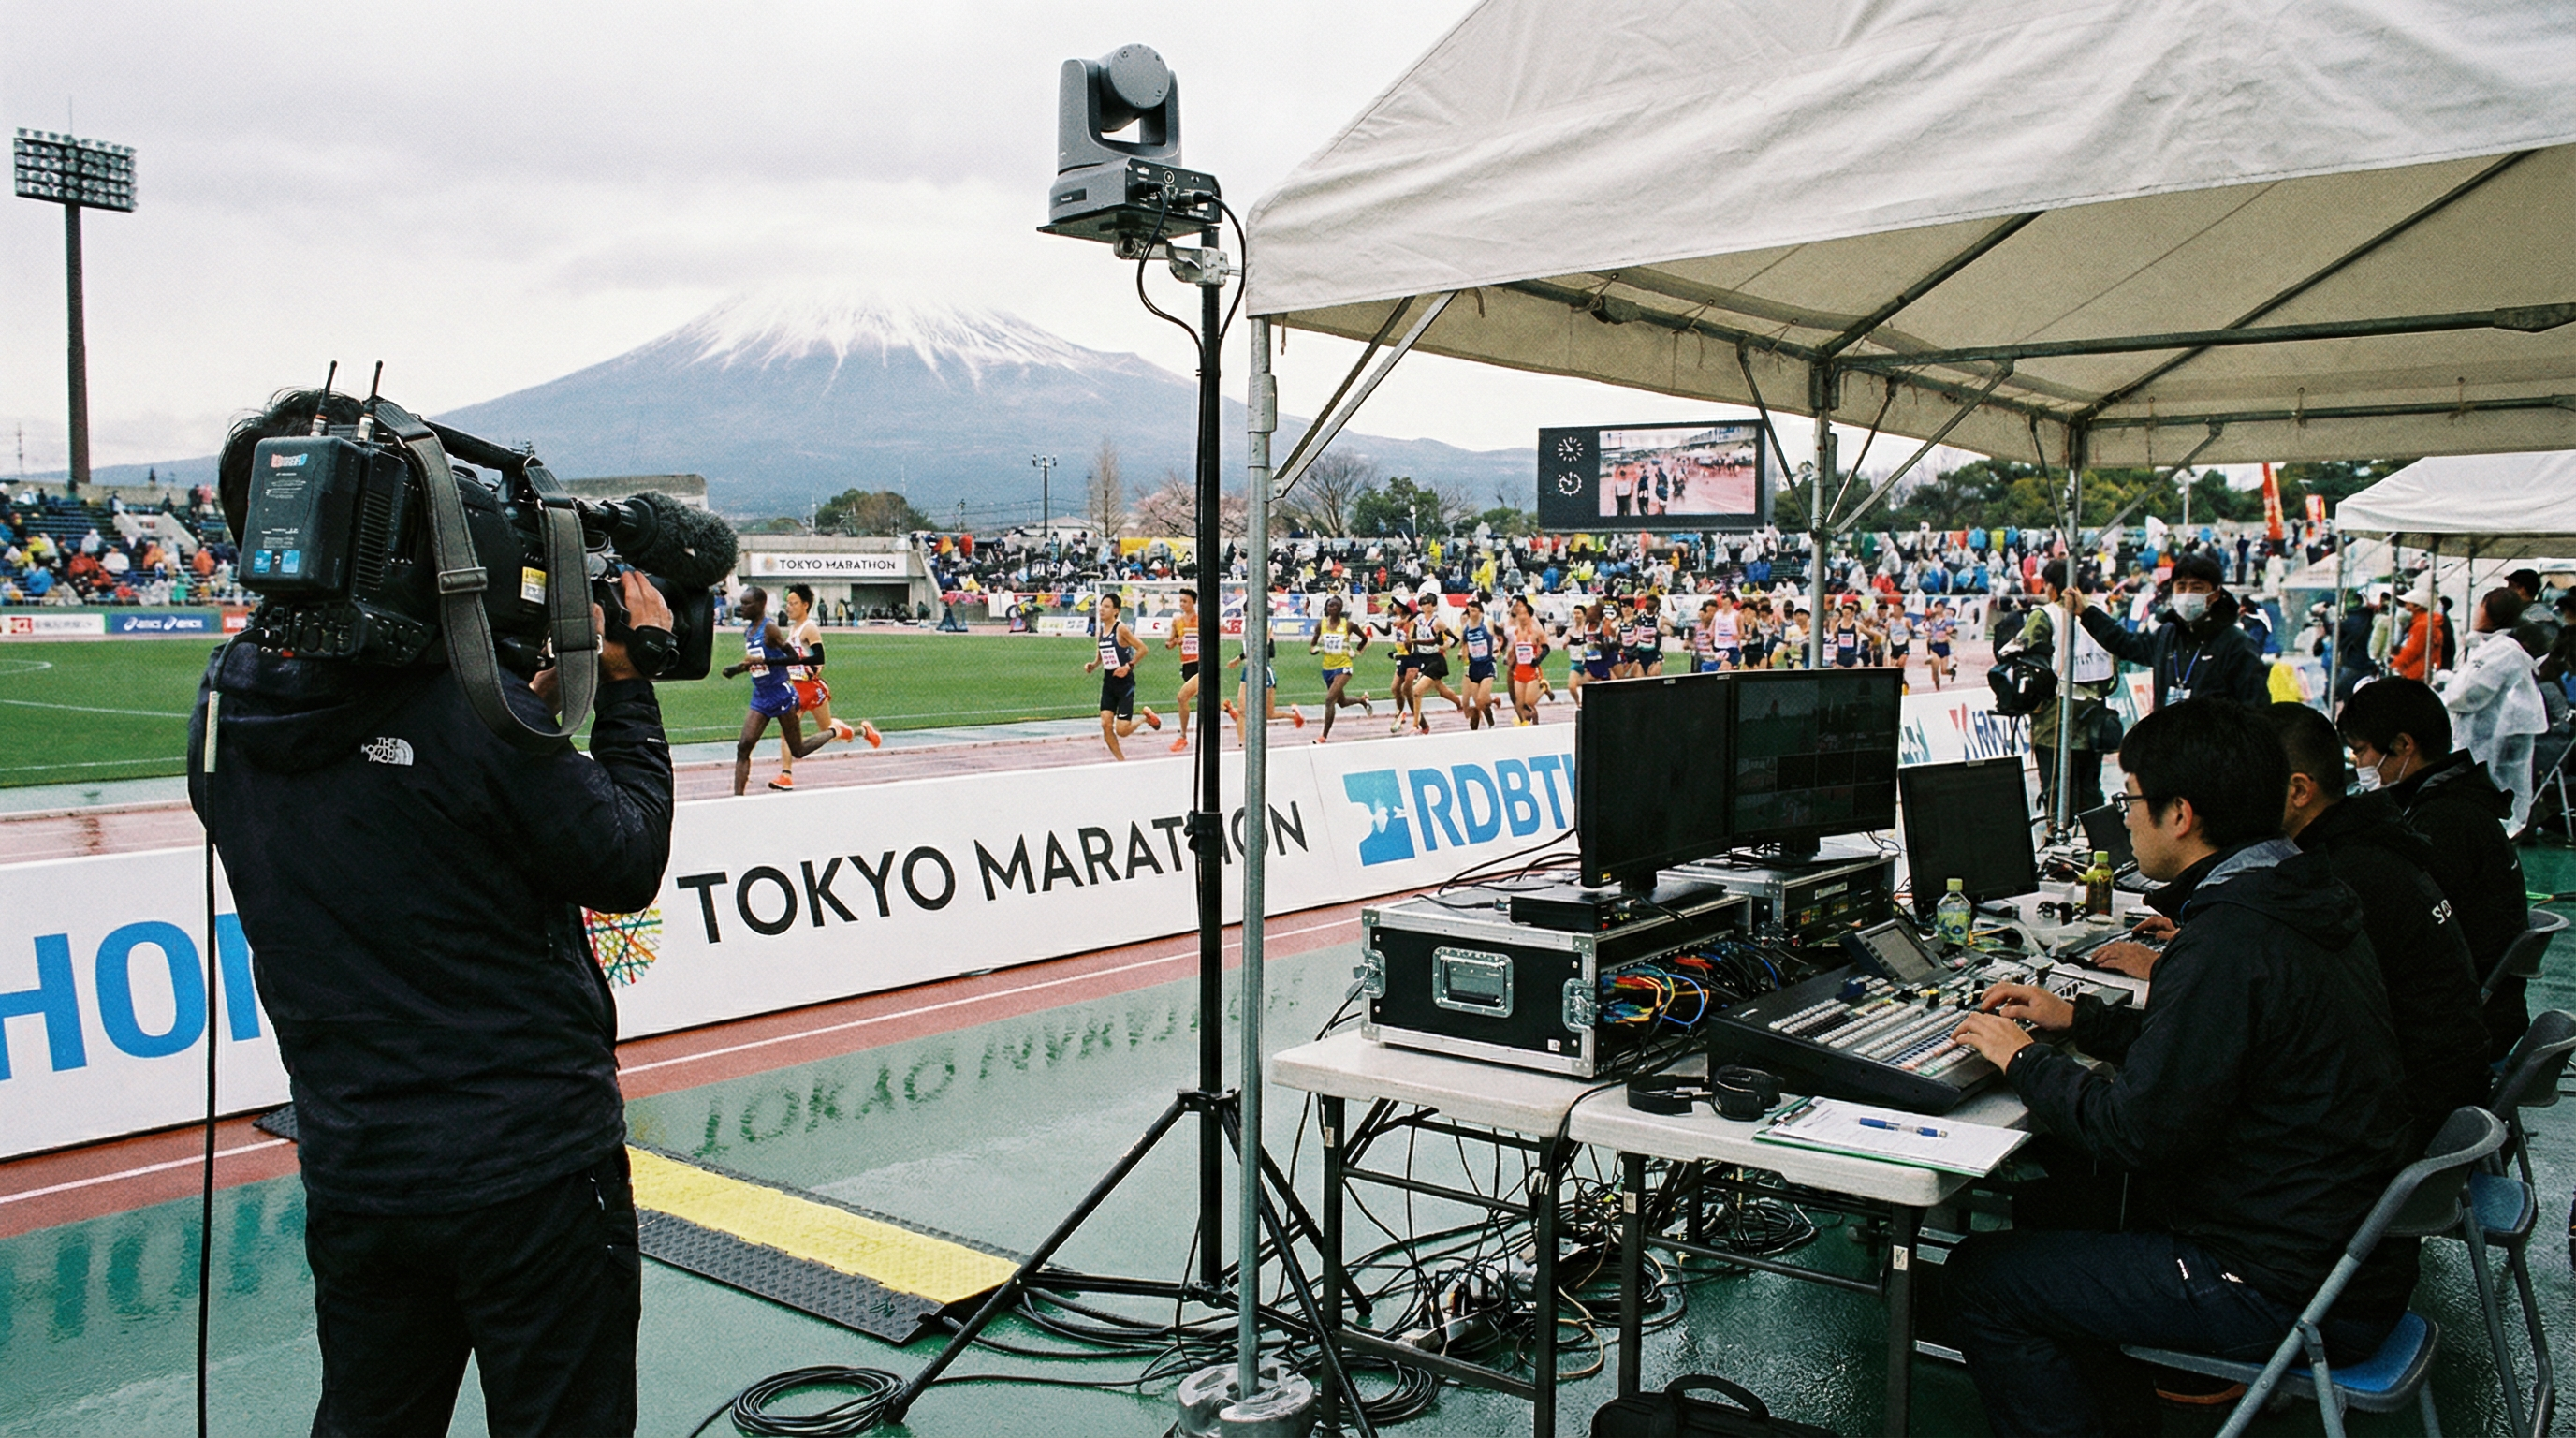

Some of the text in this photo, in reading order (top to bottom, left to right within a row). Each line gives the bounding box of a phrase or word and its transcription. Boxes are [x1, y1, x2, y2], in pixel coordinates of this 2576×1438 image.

[779, 559, 896, 570] TOKYO MARATHON
[677, 800, 1309, 945] TOKYO MARATON
